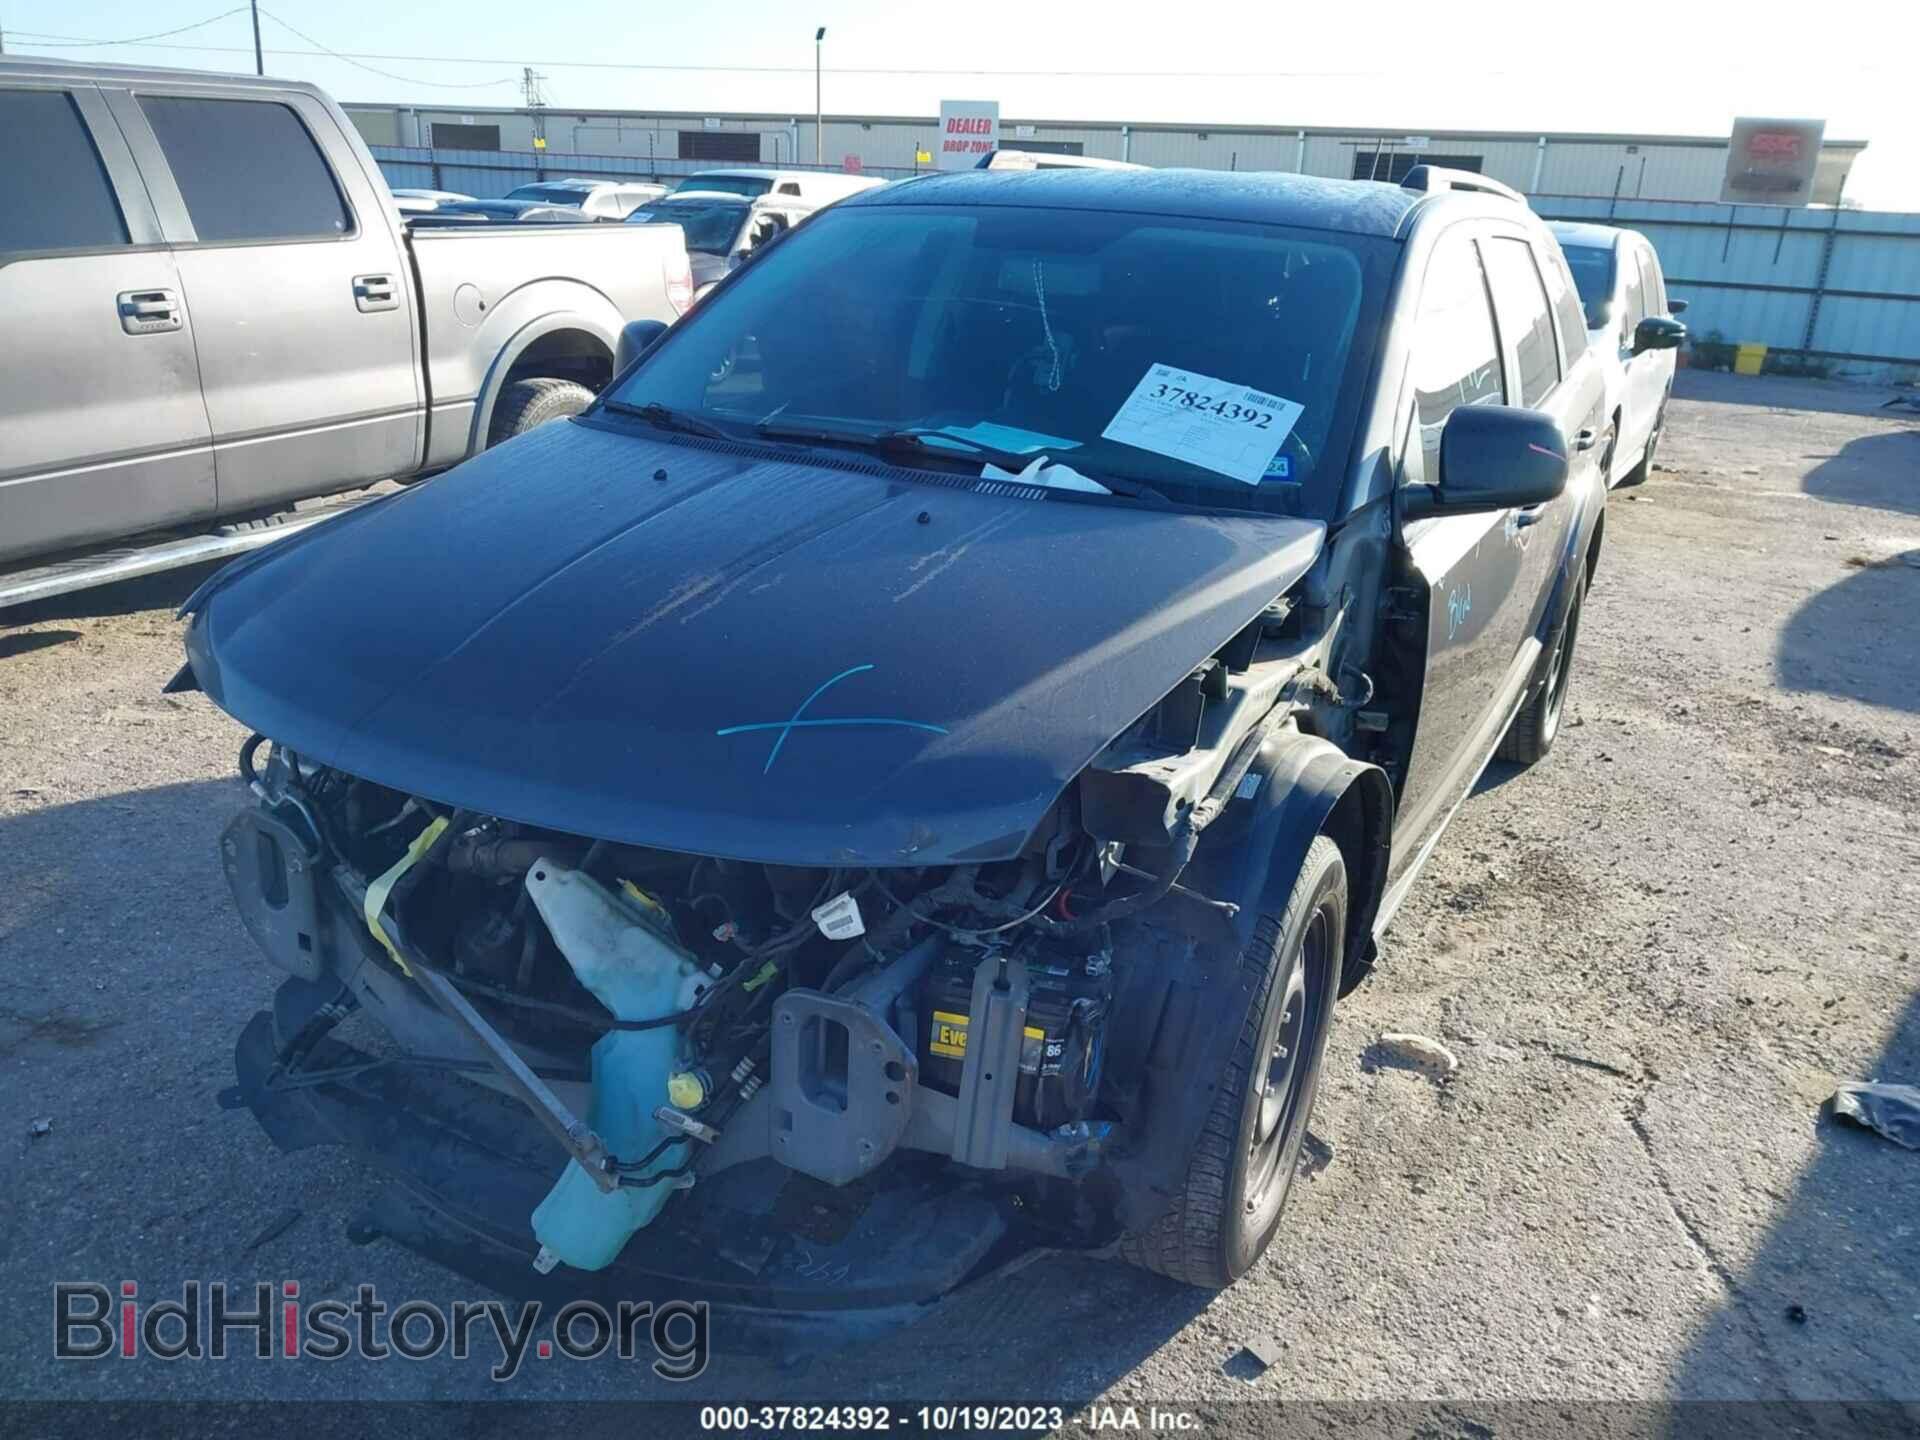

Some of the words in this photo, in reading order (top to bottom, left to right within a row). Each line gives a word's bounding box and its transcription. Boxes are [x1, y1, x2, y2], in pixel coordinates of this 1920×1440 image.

[946, 117, 992, 134] DEALER
[943, 140, 970, 152] DROP
[970, 140, 993, 153] ZONE
[1150, 383, 1273, 429] 37824392
[1046, 1044, 1062, 1057] 86
